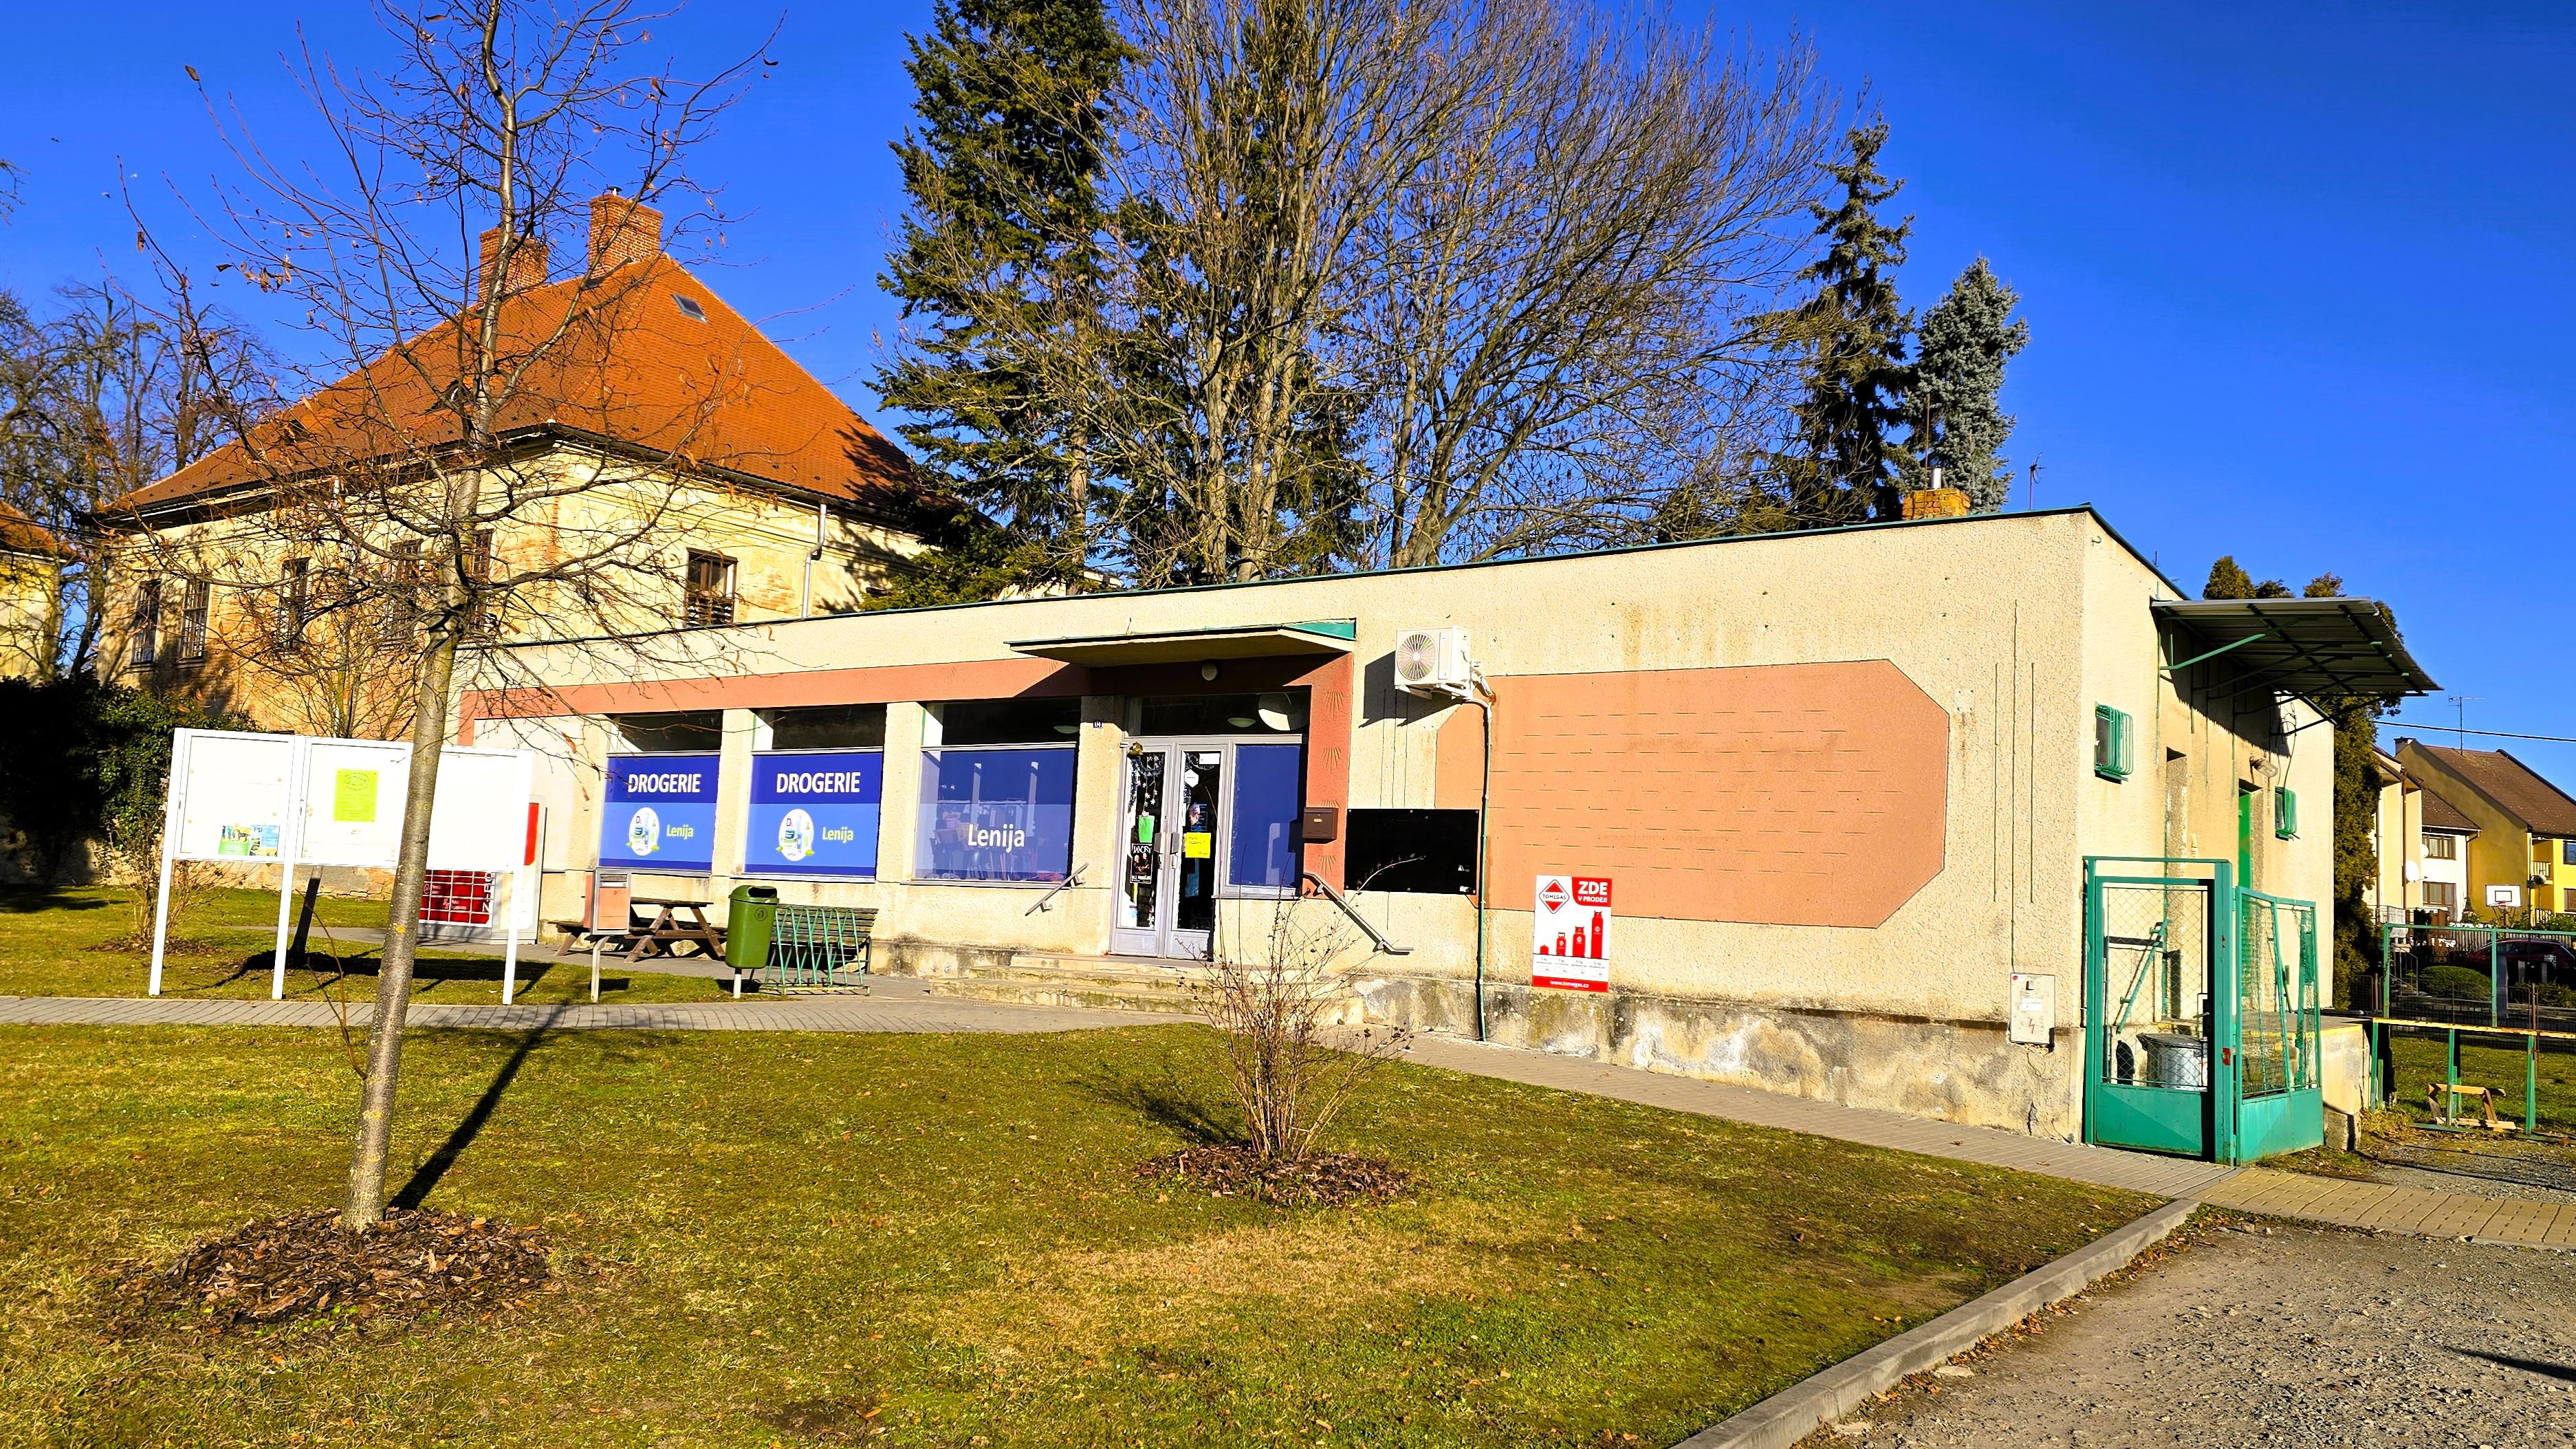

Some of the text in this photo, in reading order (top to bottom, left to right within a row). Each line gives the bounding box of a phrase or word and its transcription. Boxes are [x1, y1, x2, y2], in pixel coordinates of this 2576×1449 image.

[628, 774, 701, 793] DROGERIE
[776, 772, 861, 793] DROGERIE
[666, 824, 694, 840] Lenija
[822, 826, 854, 844] Lenija
[968, 824, 1025, 853] Lenija
[1578, 881, 1608, 895] ZDE
